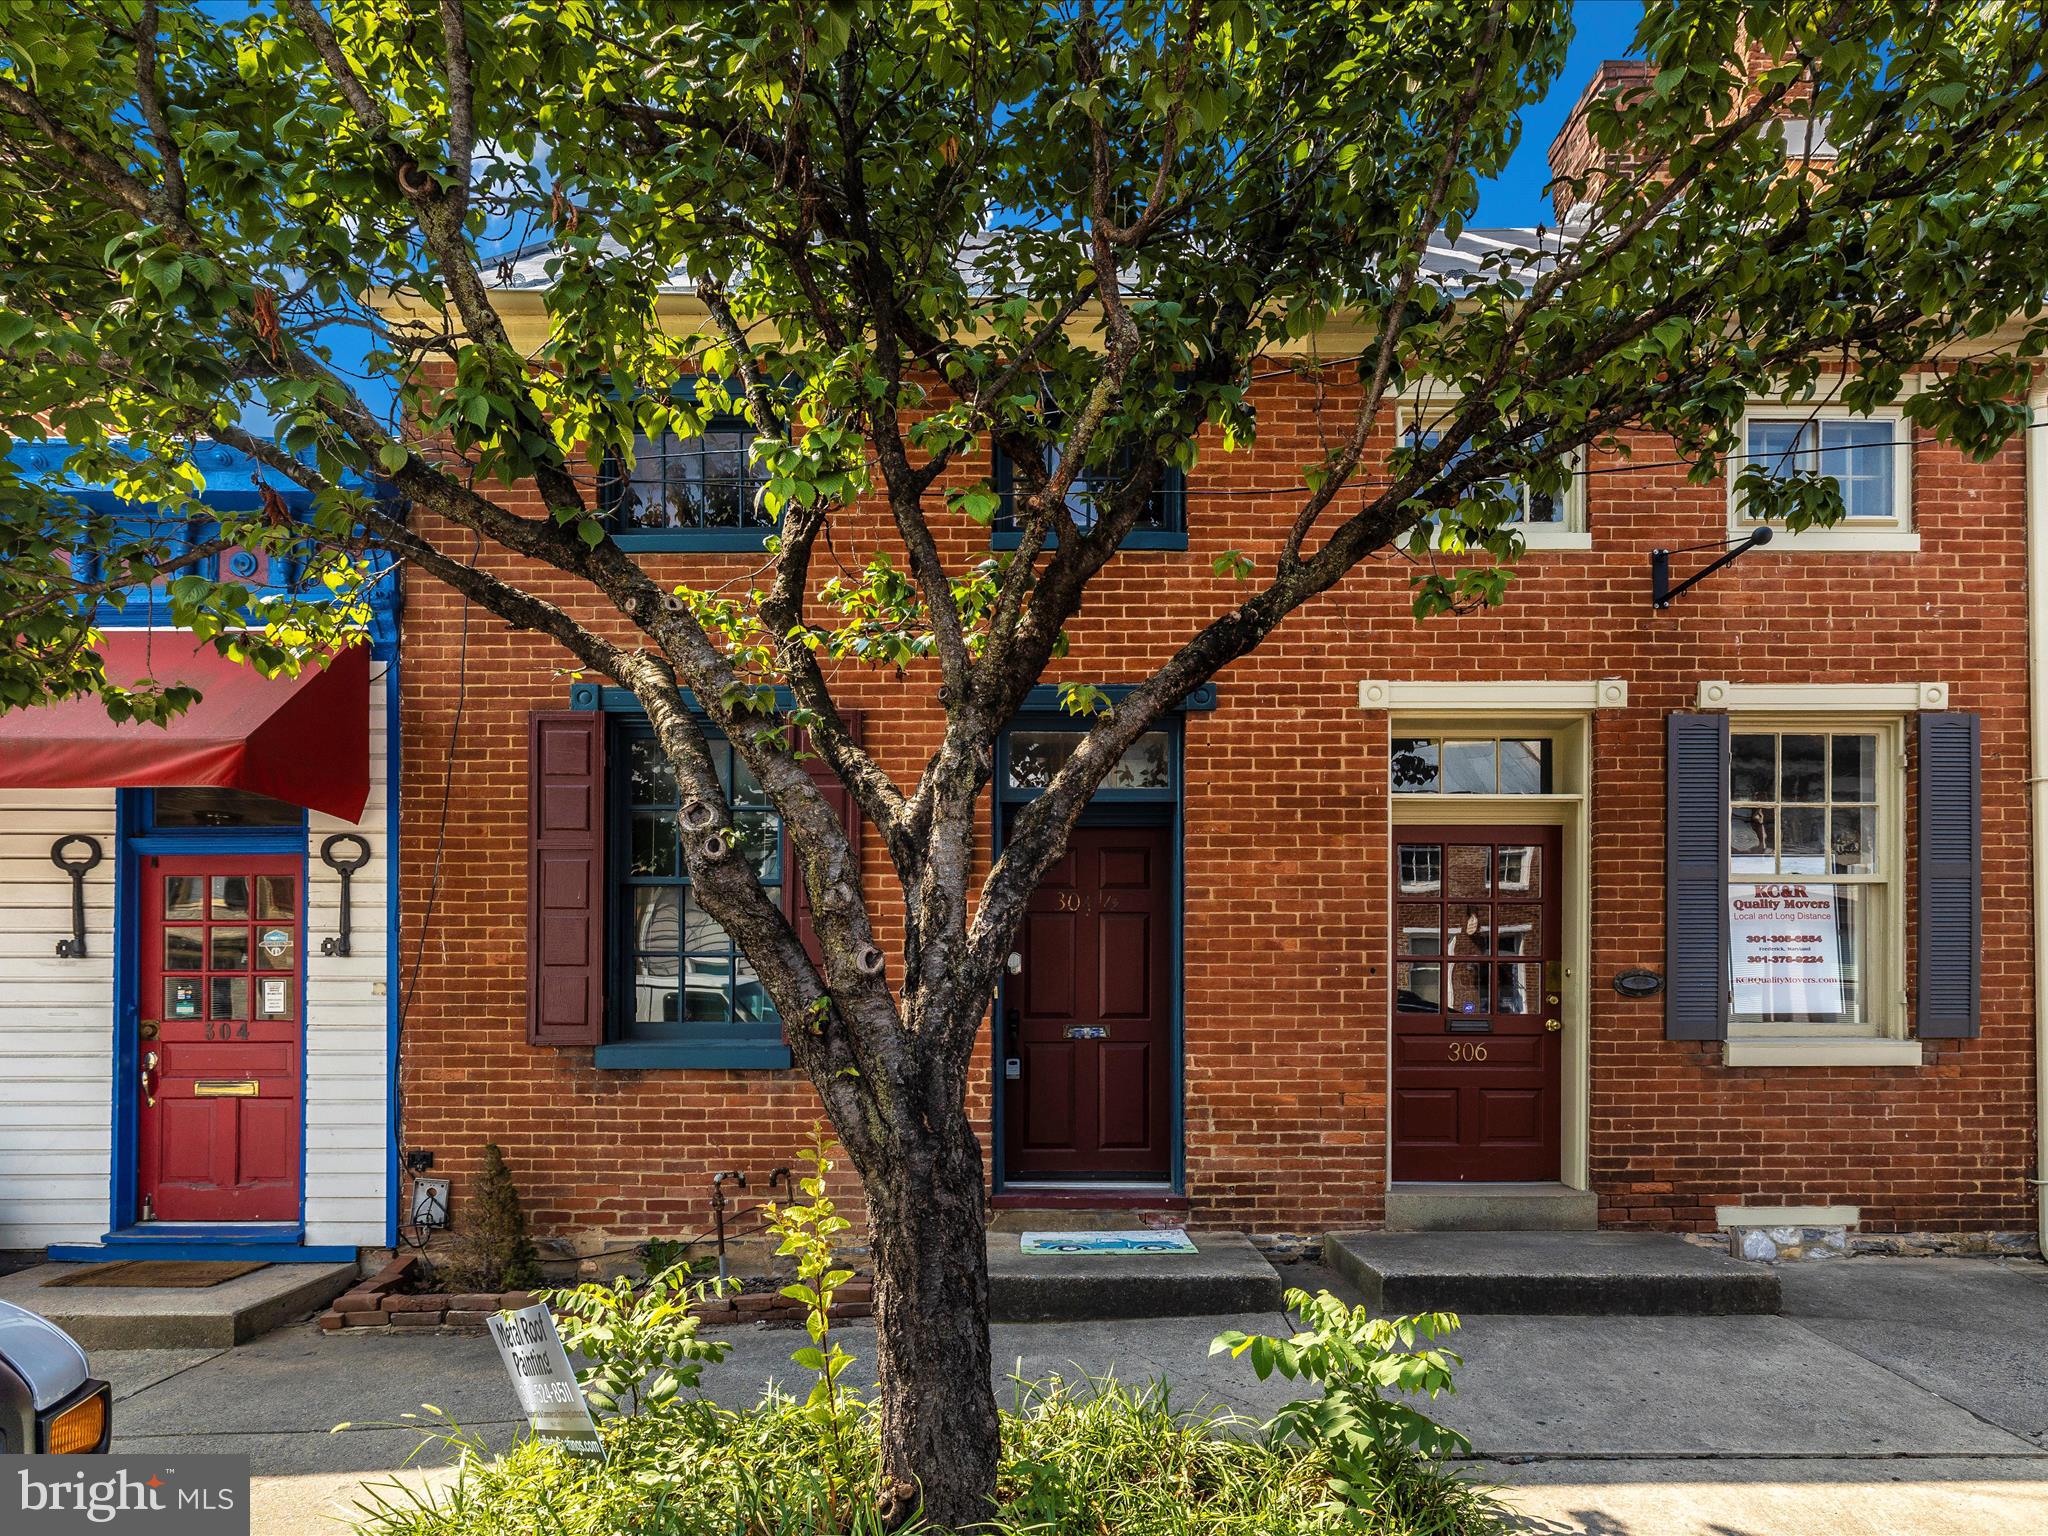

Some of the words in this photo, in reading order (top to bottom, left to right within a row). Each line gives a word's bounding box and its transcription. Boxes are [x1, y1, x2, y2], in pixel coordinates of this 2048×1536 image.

[1754, 884, 1809, 898] KC&R
[1733, 899, 1780, 911] Quality
[1784, 899, 1830, 910] Movers
[1733, 912, 1756, 921] Local
[1758, 912, 1773, 921] and
[1775, 912, 1796, 922] Long
[1797, 912, 1831, 921] Distance
[205, 1023, 250, 1040] 304
[1447, 1041, 1488, 1062] 306
[495, 1318, 522, 1348] Metal
[520, 1312, 548, 1345] Roof
[512, 1349, 552, 1377] Painting
